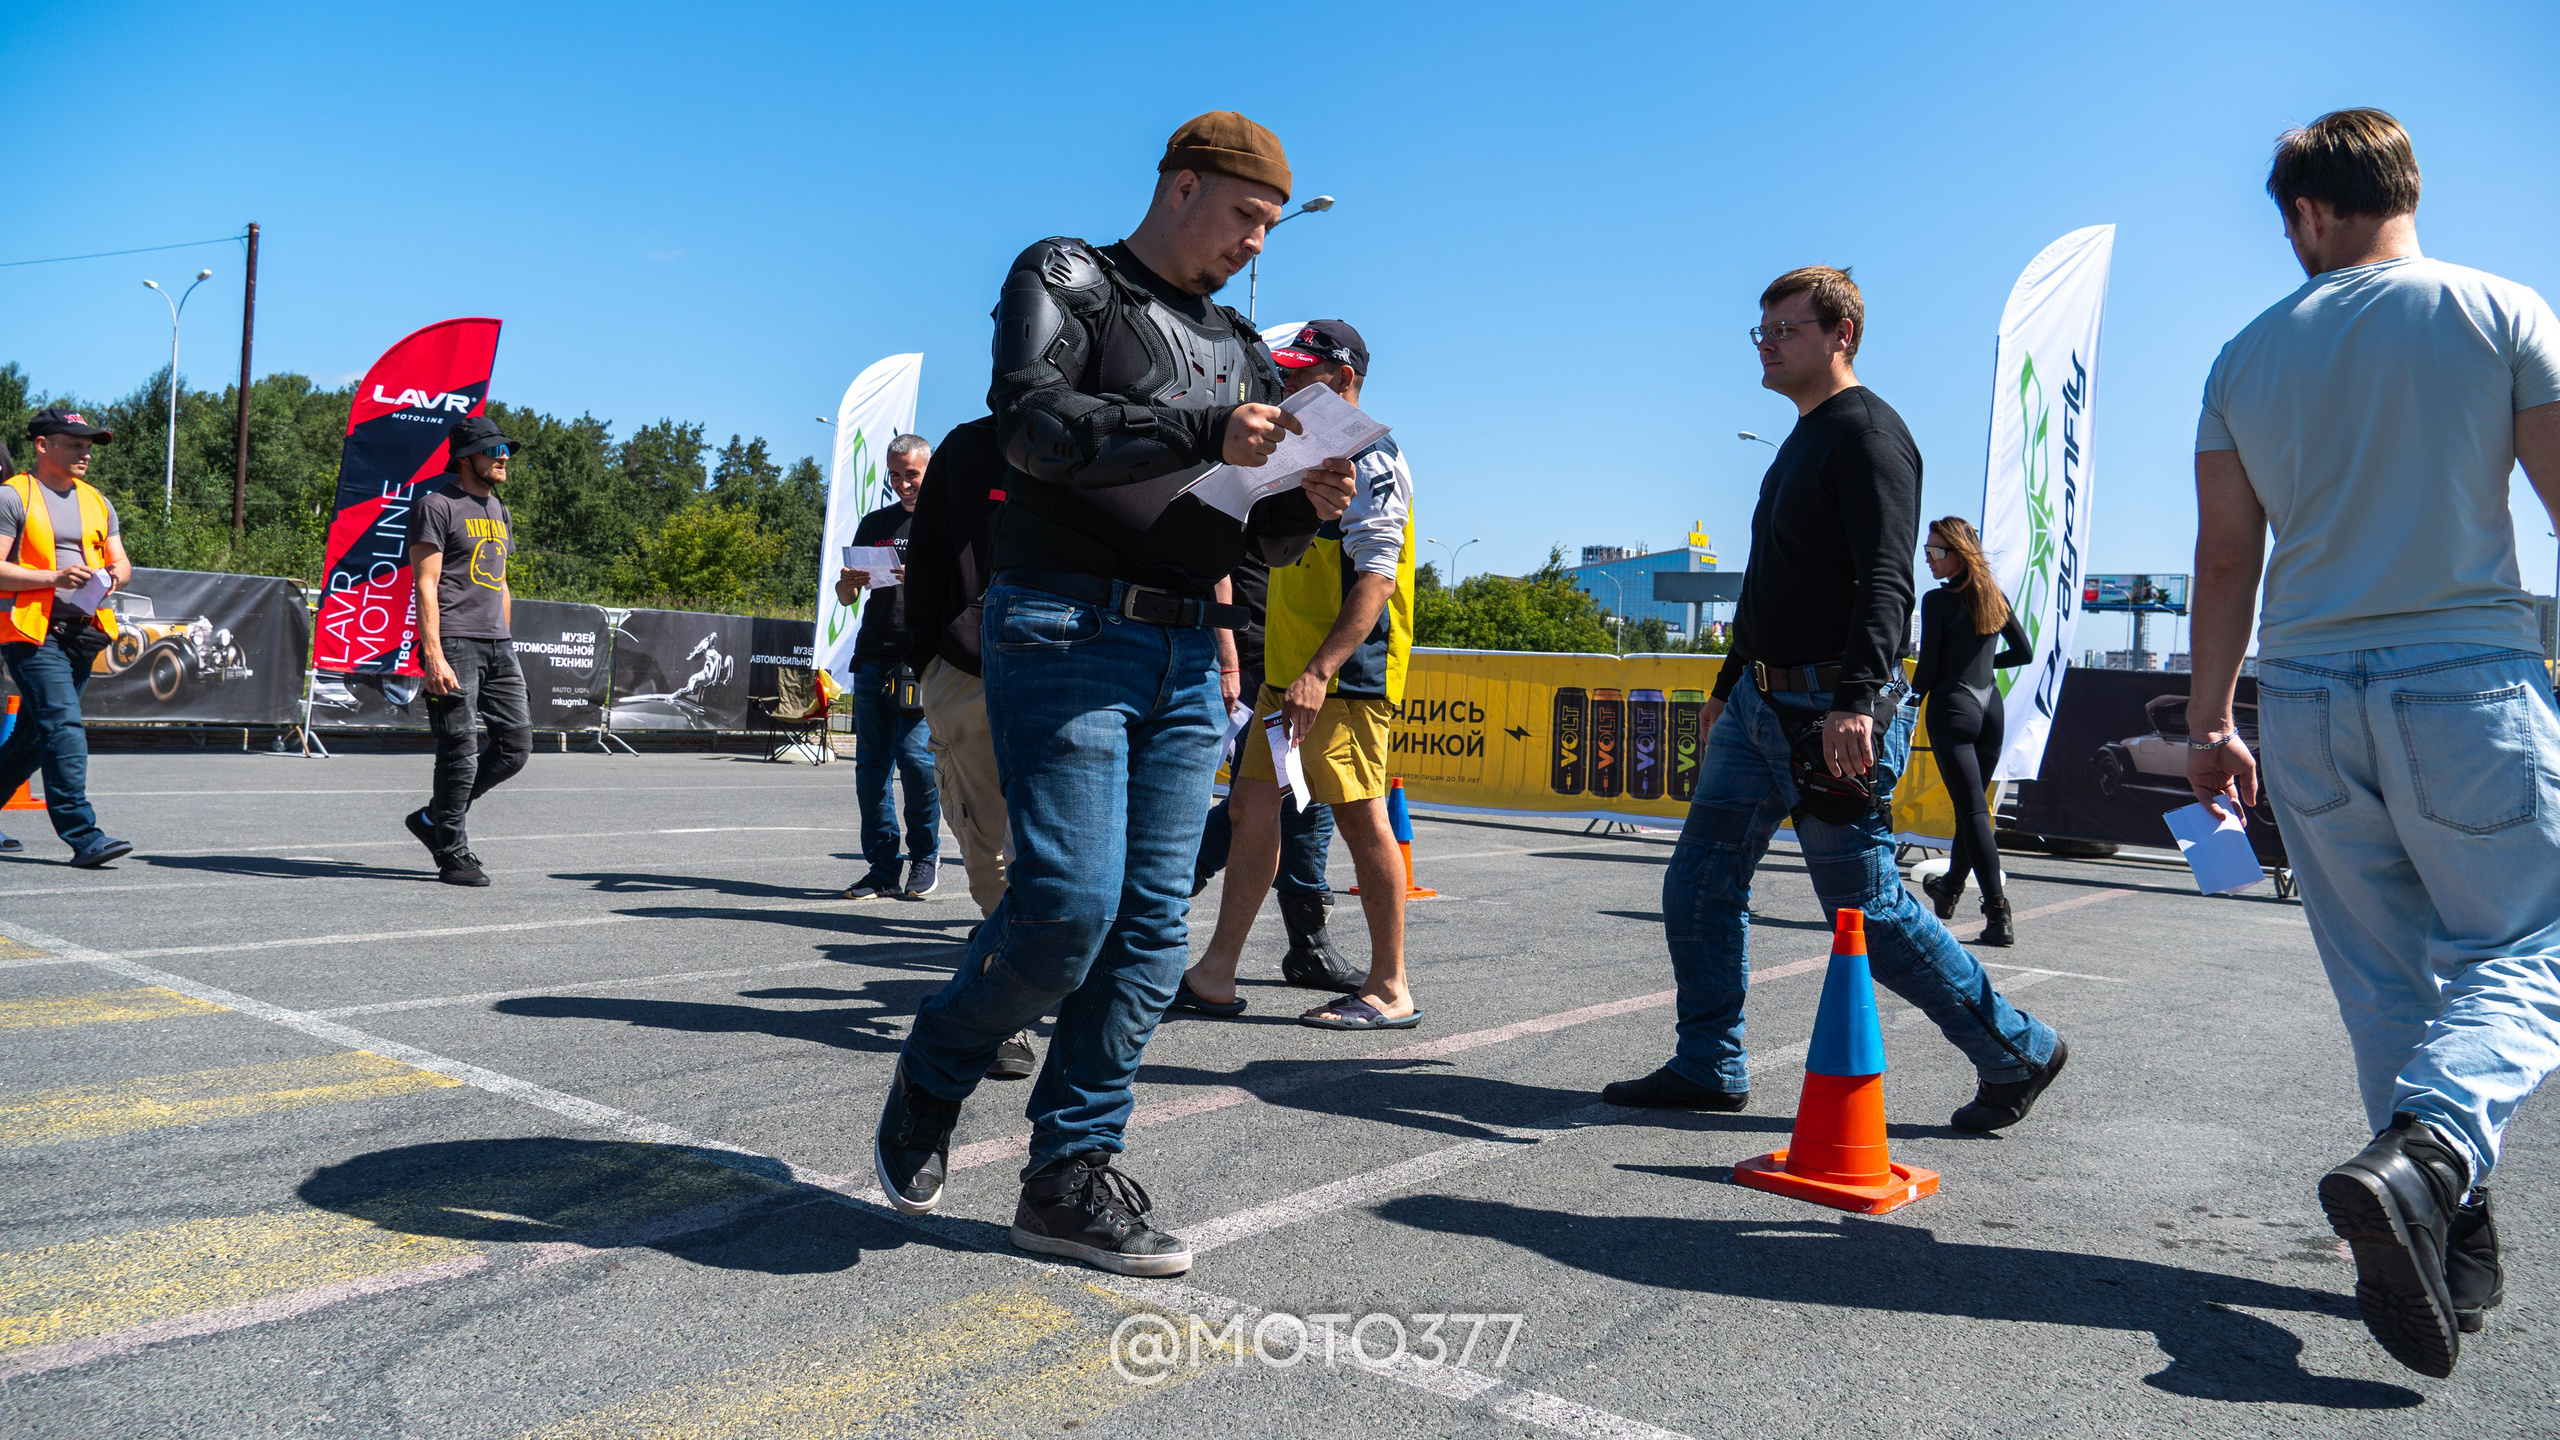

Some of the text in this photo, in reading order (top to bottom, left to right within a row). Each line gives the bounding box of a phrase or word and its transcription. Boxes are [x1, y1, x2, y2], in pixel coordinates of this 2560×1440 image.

[372, 384, 471, 414] LAVR
[391, 412, 445, 425] MOTOLINE
[354, 479, 414, 666] MOTOLINE
[320, 570, 363, 664] LAVR
[561, 631, 596, 644] МУЗЕЙ
[394, 620, 415, 670] Твое
[512, 641, 595, 656] ВТОМОБИЛЬНОЙ
[549, 656, 594, 669] ТЕХНИКИ
[749, 654, 812, 667] АВТОМОБИЛЬНО
[1561, 705, 1580, 768] VOLT
[1598, 706, 1616, 770] VOLT
[1636, 707, 1657, 772] VOLT
[1676, 708, 1697, 774] VOLT
